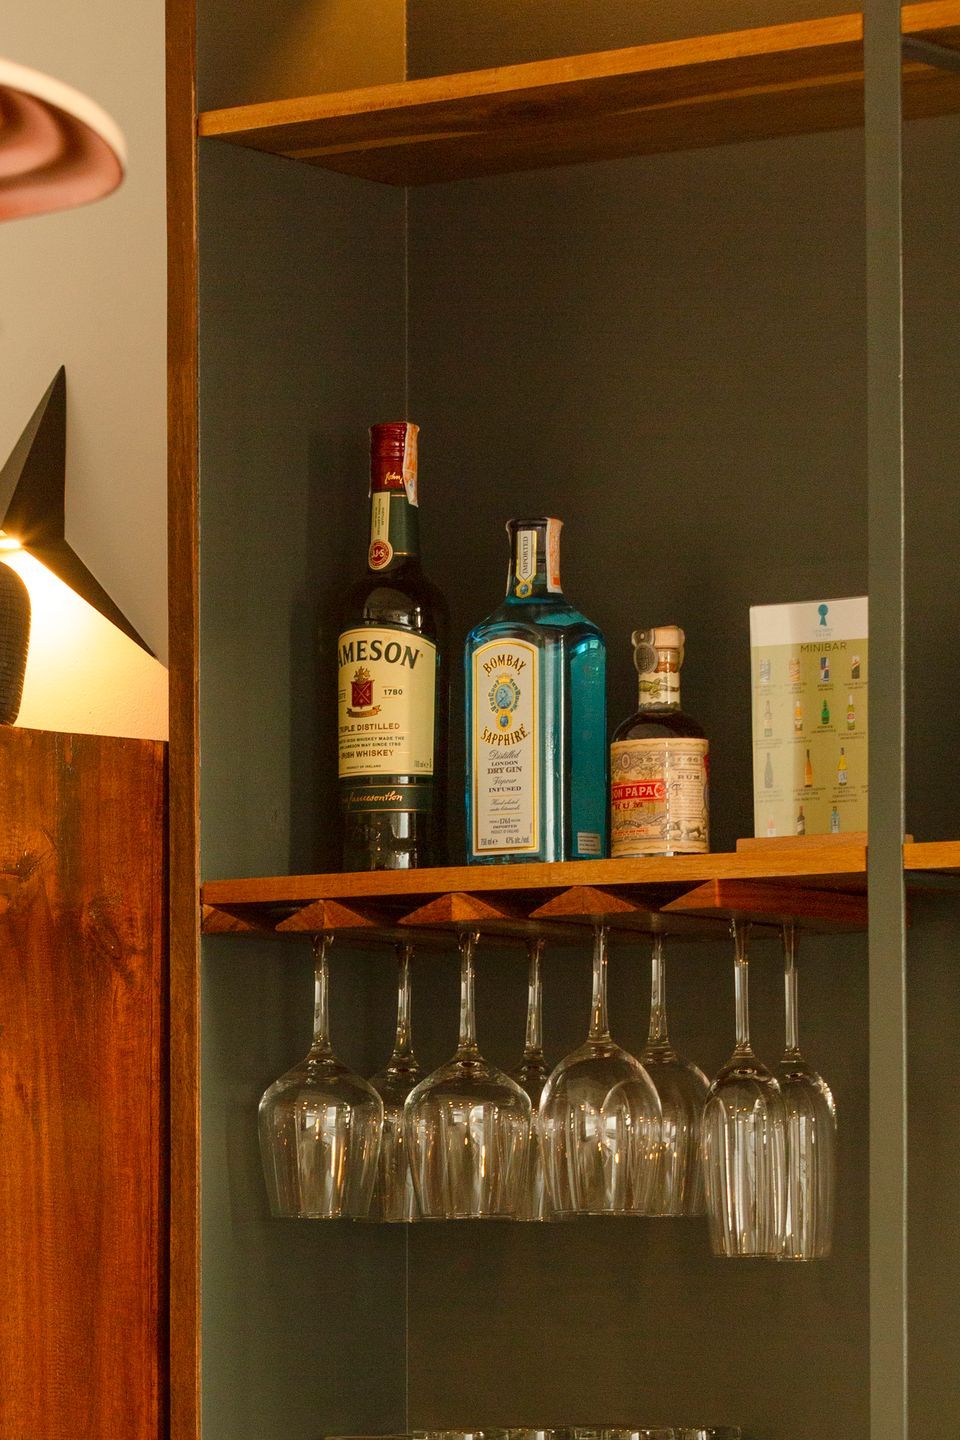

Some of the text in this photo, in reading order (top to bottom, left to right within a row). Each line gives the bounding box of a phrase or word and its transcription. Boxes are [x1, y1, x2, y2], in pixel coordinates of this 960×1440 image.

[800, 642, 847, 653] MINIBAR
[482, 653, 527, 677] BOMBAY
[383, 688, 403, 696] 1780
[356, 722, 401, 732] DISTILLED
[480, 723, 530, 746] SAPPHIRE
[356, 749, 395, 758] WHISKEY
[487, 765, 523, 775] DRY GIN
[488, 785, 522, 793] INFUSED
[625, 786, 654, 797] PAPA
